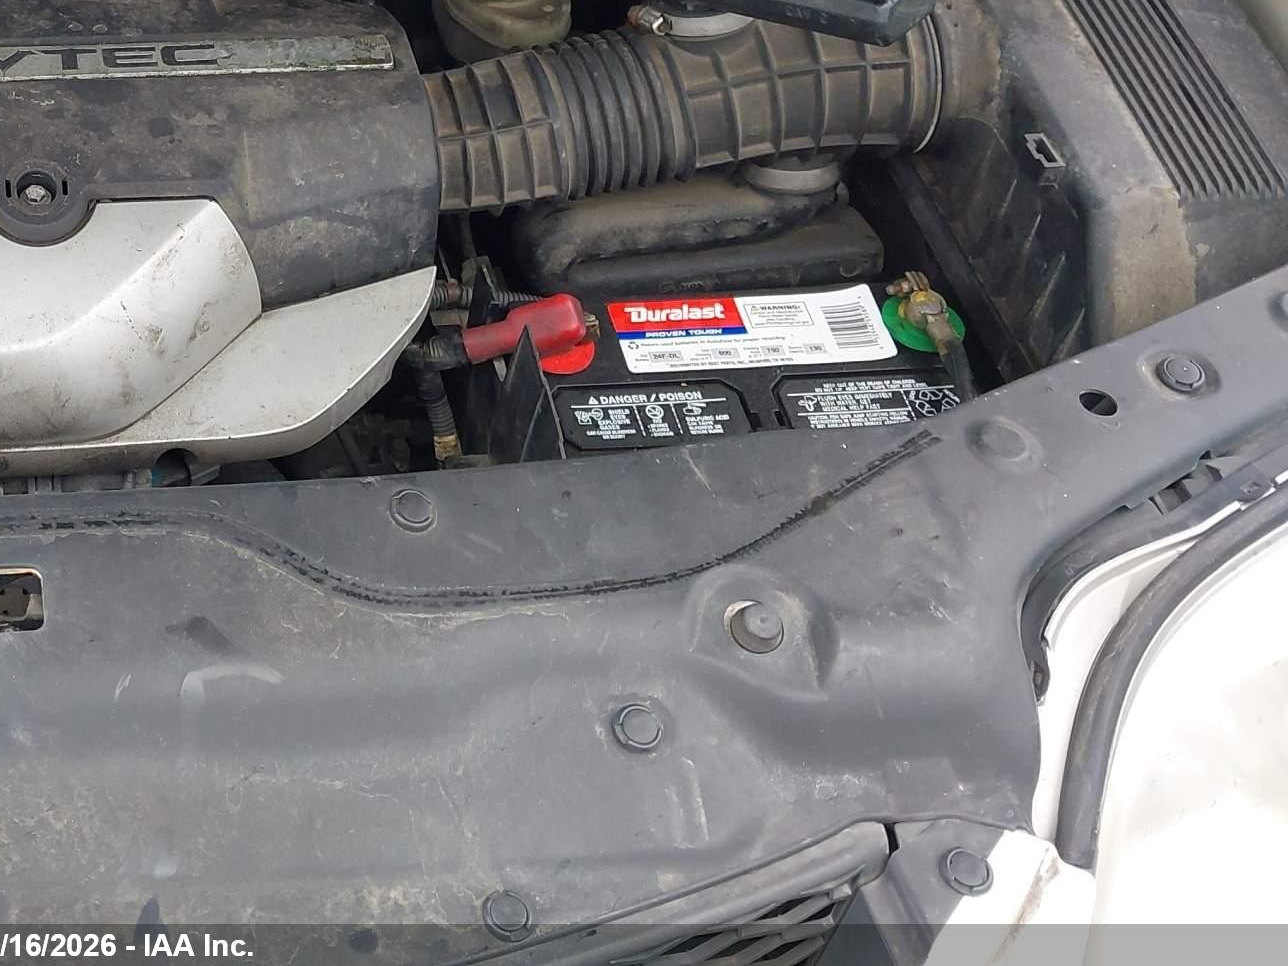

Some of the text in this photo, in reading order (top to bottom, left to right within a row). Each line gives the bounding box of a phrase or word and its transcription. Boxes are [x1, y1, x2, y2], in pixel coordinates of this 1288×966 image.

[624, 302, 725, 323] Duralast
[645, 328, 722, 338] PROVEN TOUGH
[600, 391, 703, 404] DANGER / POISON
